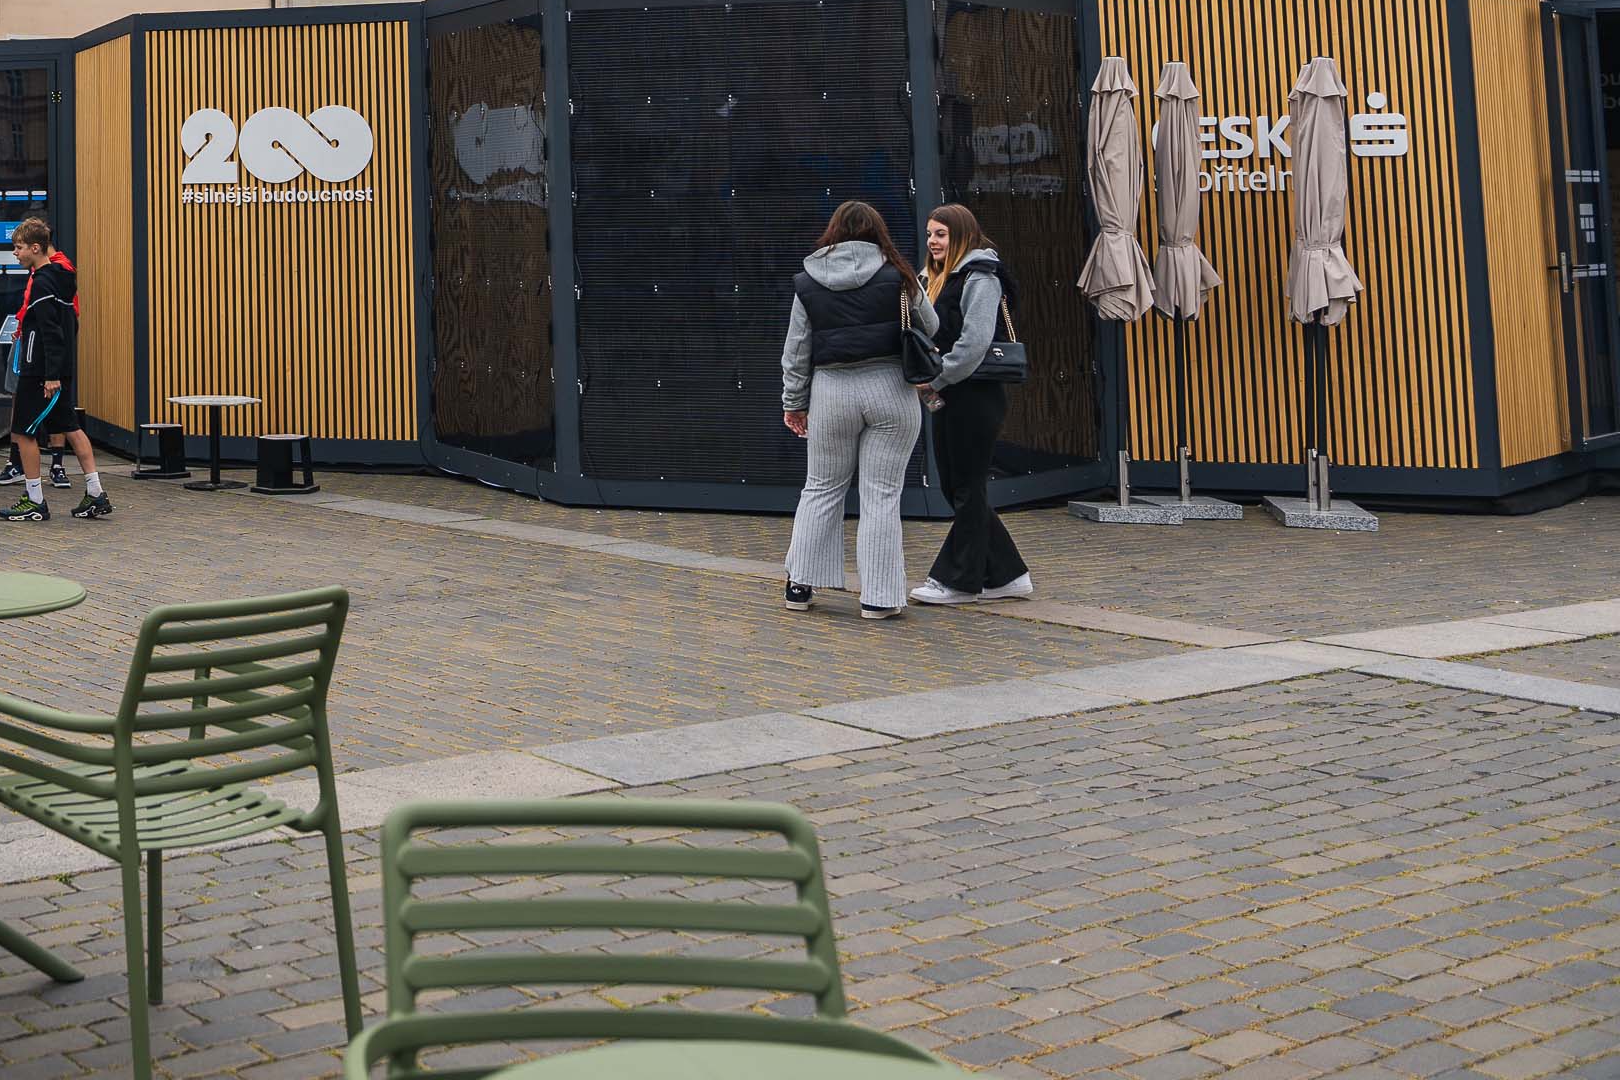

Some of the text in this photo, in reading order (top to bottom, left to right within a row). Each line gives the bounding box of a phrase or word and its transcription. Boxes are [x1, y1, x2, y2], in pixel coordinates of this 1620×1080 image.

[1152, 116, 1292, 159] ESK
[1154, 166, 1293, 192] ořiteln
[182, 186, 372, 207] #silnější budoucnost
